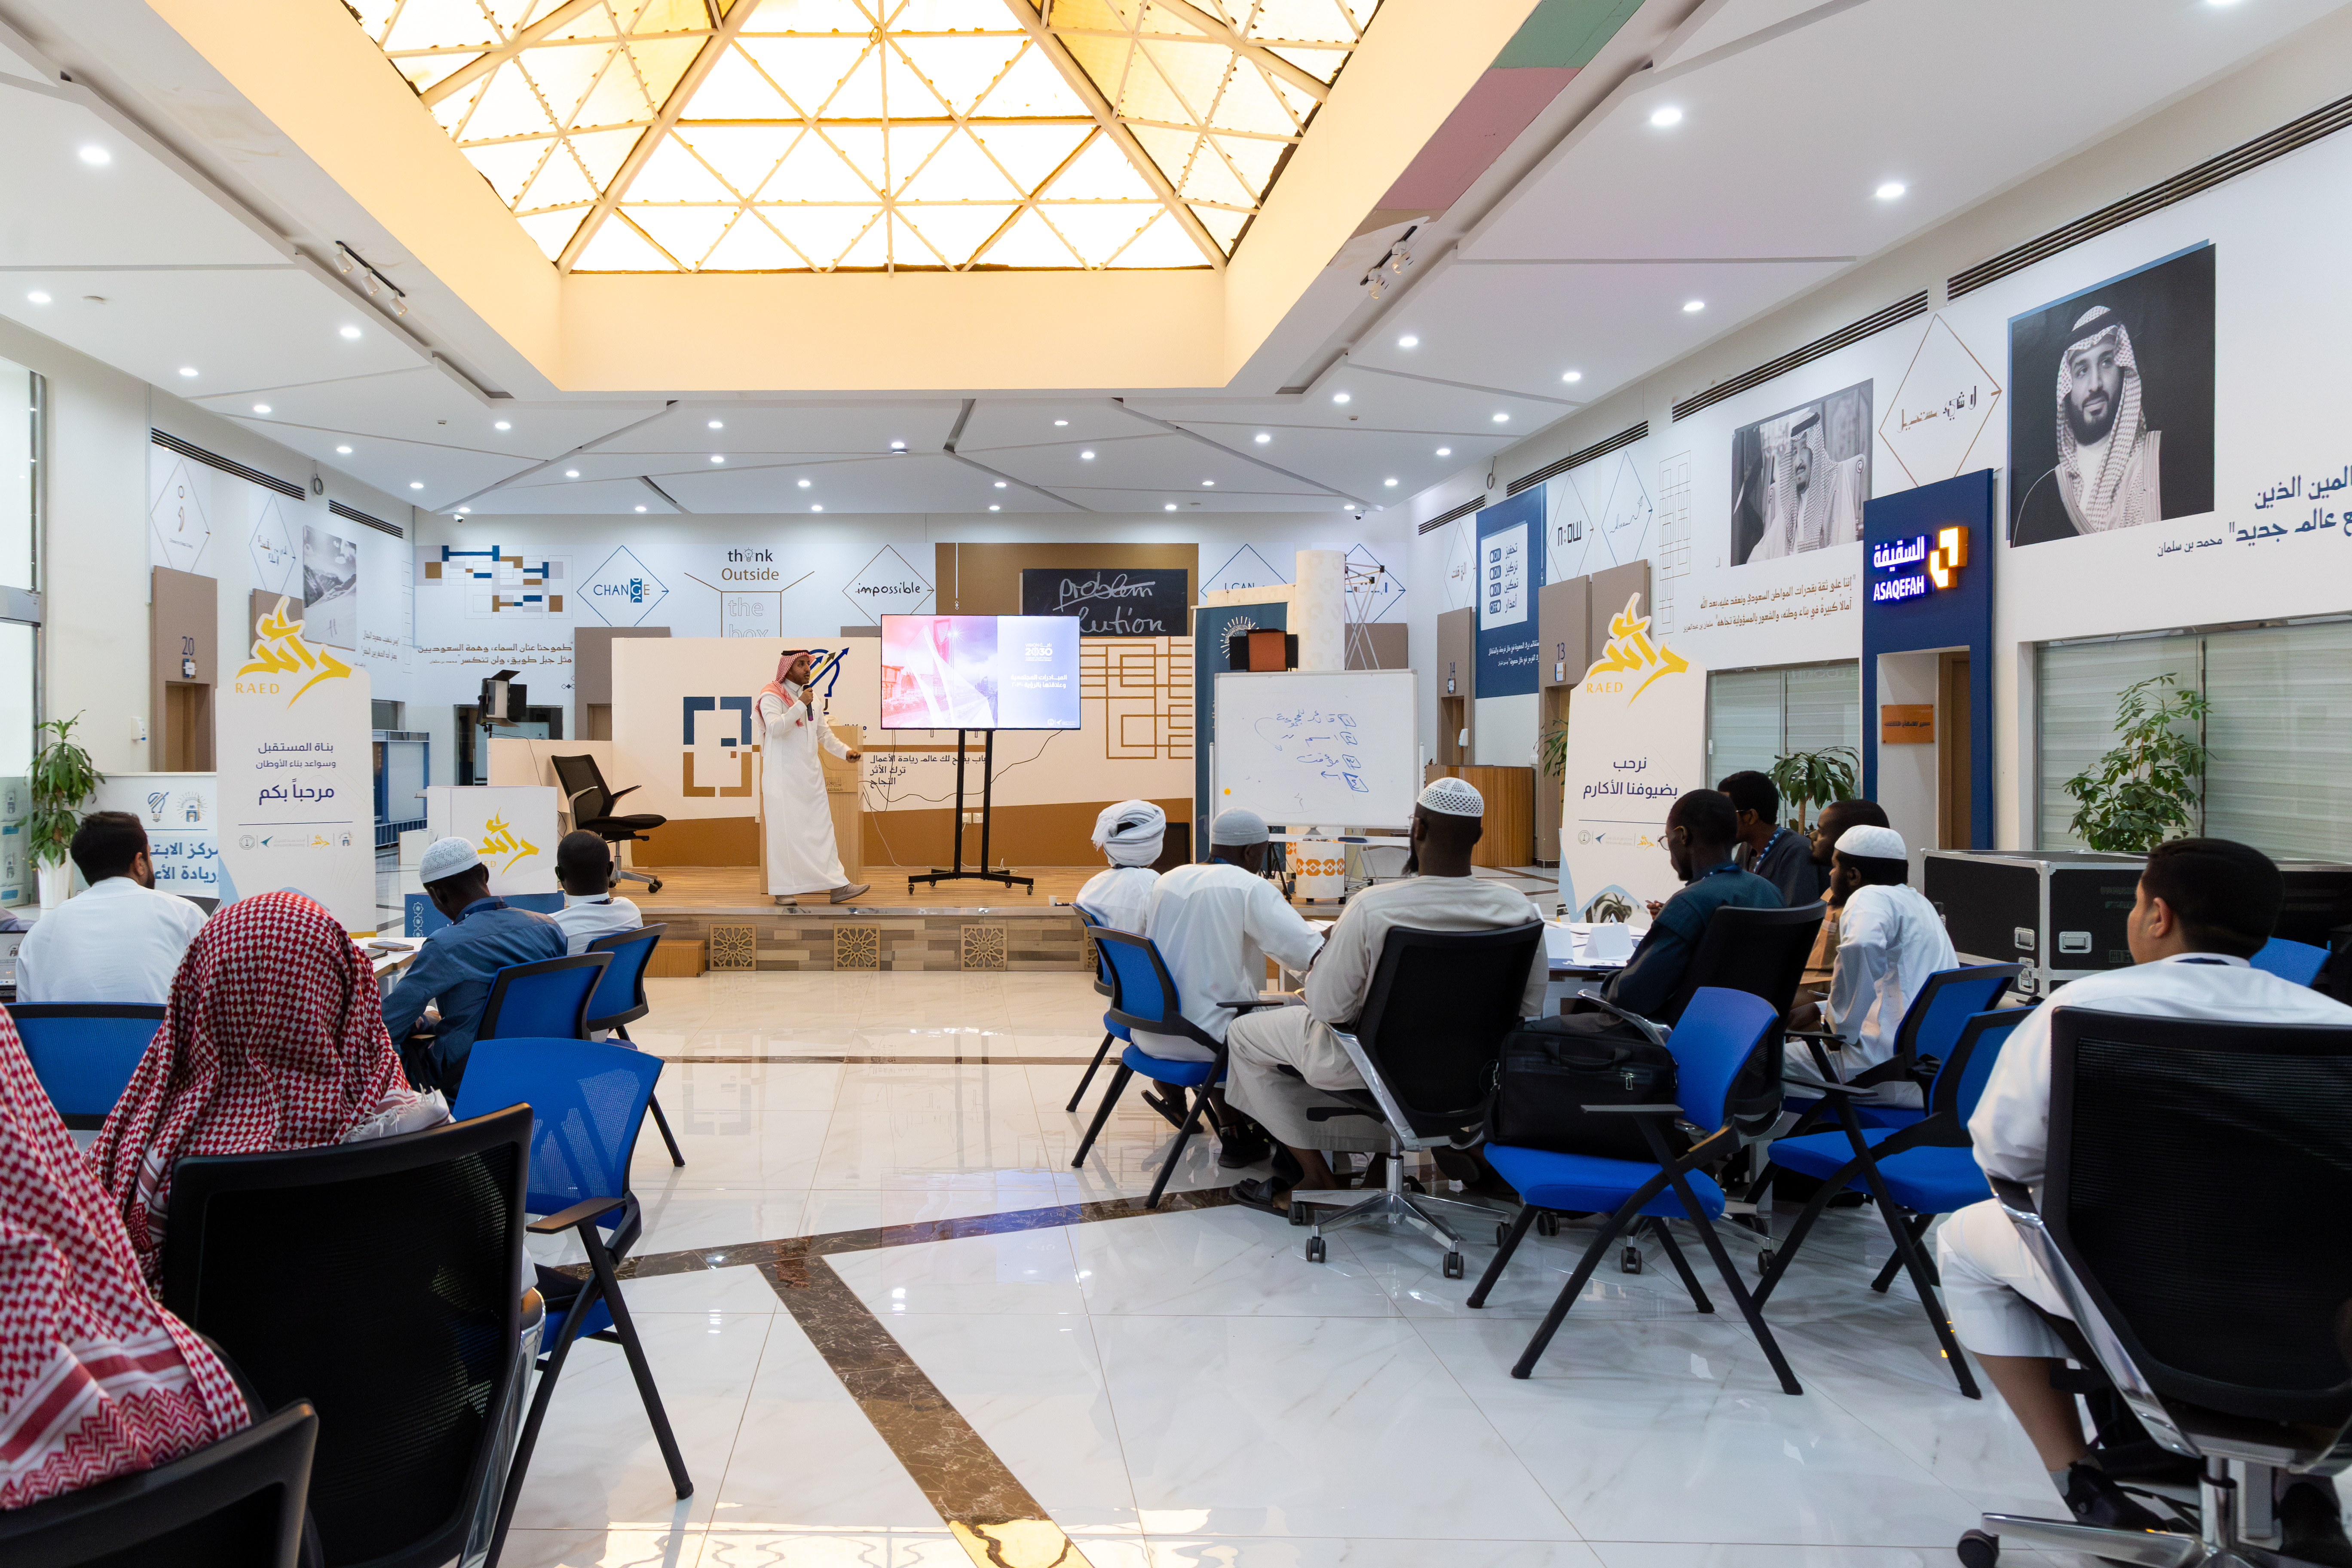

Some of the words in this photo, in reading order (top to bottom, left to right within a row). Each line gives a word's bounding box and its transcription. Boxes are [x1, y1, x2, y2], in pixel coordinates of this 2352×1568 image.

[2255, 475, 2301, 510] الذين
[2294, 507, 2337, 533] عالم
[2157, 541, 2182, 557] سلمان
[2184, 542, 2194, 553] بن
[2196, 538, 2223, 548] محمد
[1494, 549, 1500, 560] ON
[1874, 536, 1925, 572] السقيفة
[722, 567, 779, 580] Outside
[1494, 567, 1500, 578] ON
[855, 582, 921, 597] impossible
[1494, 584, 1500, 595] ON
[1818, 579, 1828, 591] ثقة
[1829, 579, 1842, 592] على
[1873, 575, 1925, 601] ASAQEFAH
[728, 597, 763, 616] the
[182, 636, 194, 655] 20
[418, 644, 463, 653] السعوديين
[466, 644, 489, 652] وهمة
[519, 643, 535, 652] عنان
[1557, 642, 1565, 661] 13
[491, 655, 505, 665] ولن
[539, 655, 555, 665] جبل
[557, 655, 572, 665] مثل
[1450, 662, 1455, 677] 14
[235, 683, 279, 694] RAED
[1587, 682, 1623, 693] RAED
[258, 742, 312, 754] المستقبل
[315, 742, 334, 753] بناة
[256, 759, 288, 769] الأوطان
[289, 760, 303, 769] بناء
[305, 760, 336, 768] وسواعد
[870, 753, 895, 764] الأعمال
[898, 756, 918, 764] ريادة
[870, 764, 887, 776] الأثر
[1613, 757, 1647, 773] نرحب
[870, 777, 896, 789] النجاح
[1583, 779, 1623, 799] الأكارم
[259, 784, 288, 805] بكم
[1627, 782, 1678, 799] بضيوفنا
